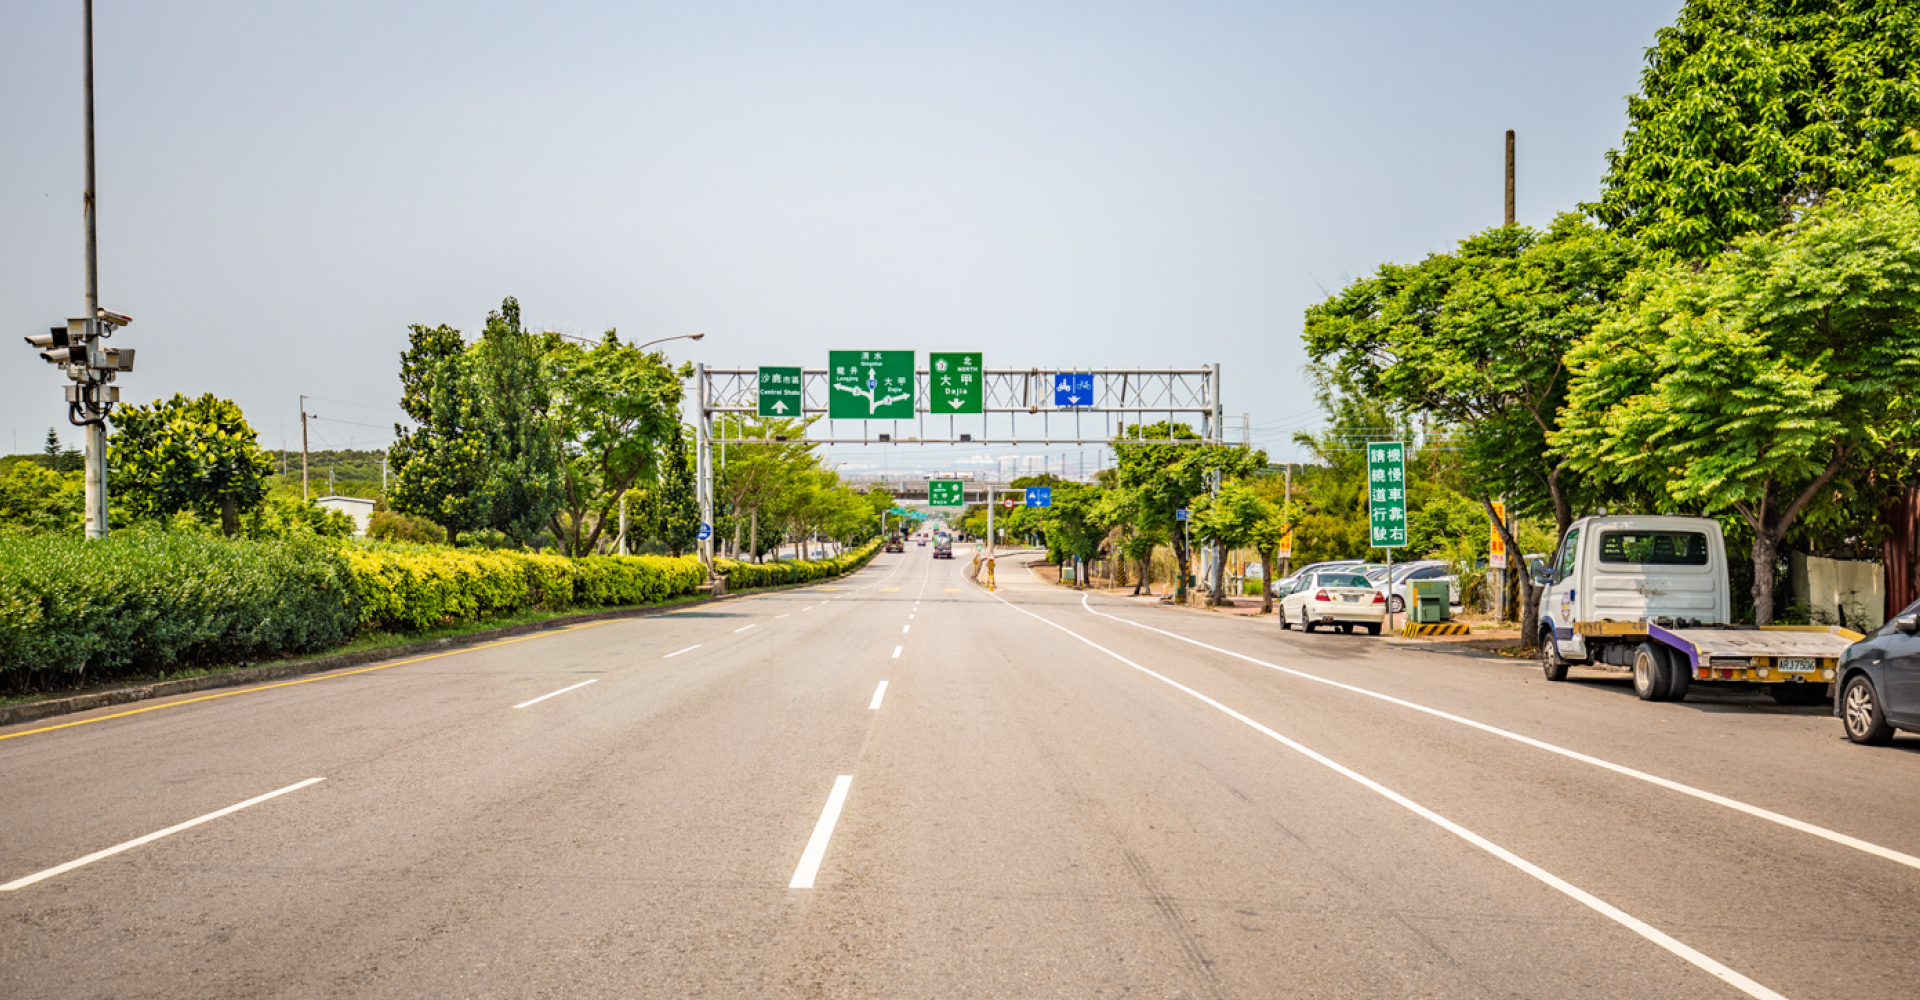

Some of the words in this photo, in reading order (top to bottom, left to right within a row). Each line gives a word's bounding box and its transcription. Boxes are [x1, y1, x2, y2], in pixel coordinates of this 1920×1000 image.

[860, 352, 882, 360] 清水
[963, 356, 972, 365] 北
[884, 377, 906, 386] 大甲
[940, 374, 972, 386] 大甲
[760, 388, 782, 396] Central
[945, 387, 968, 396] Dajia
[1387, 448, 1404, 540] 機慢車靠右
